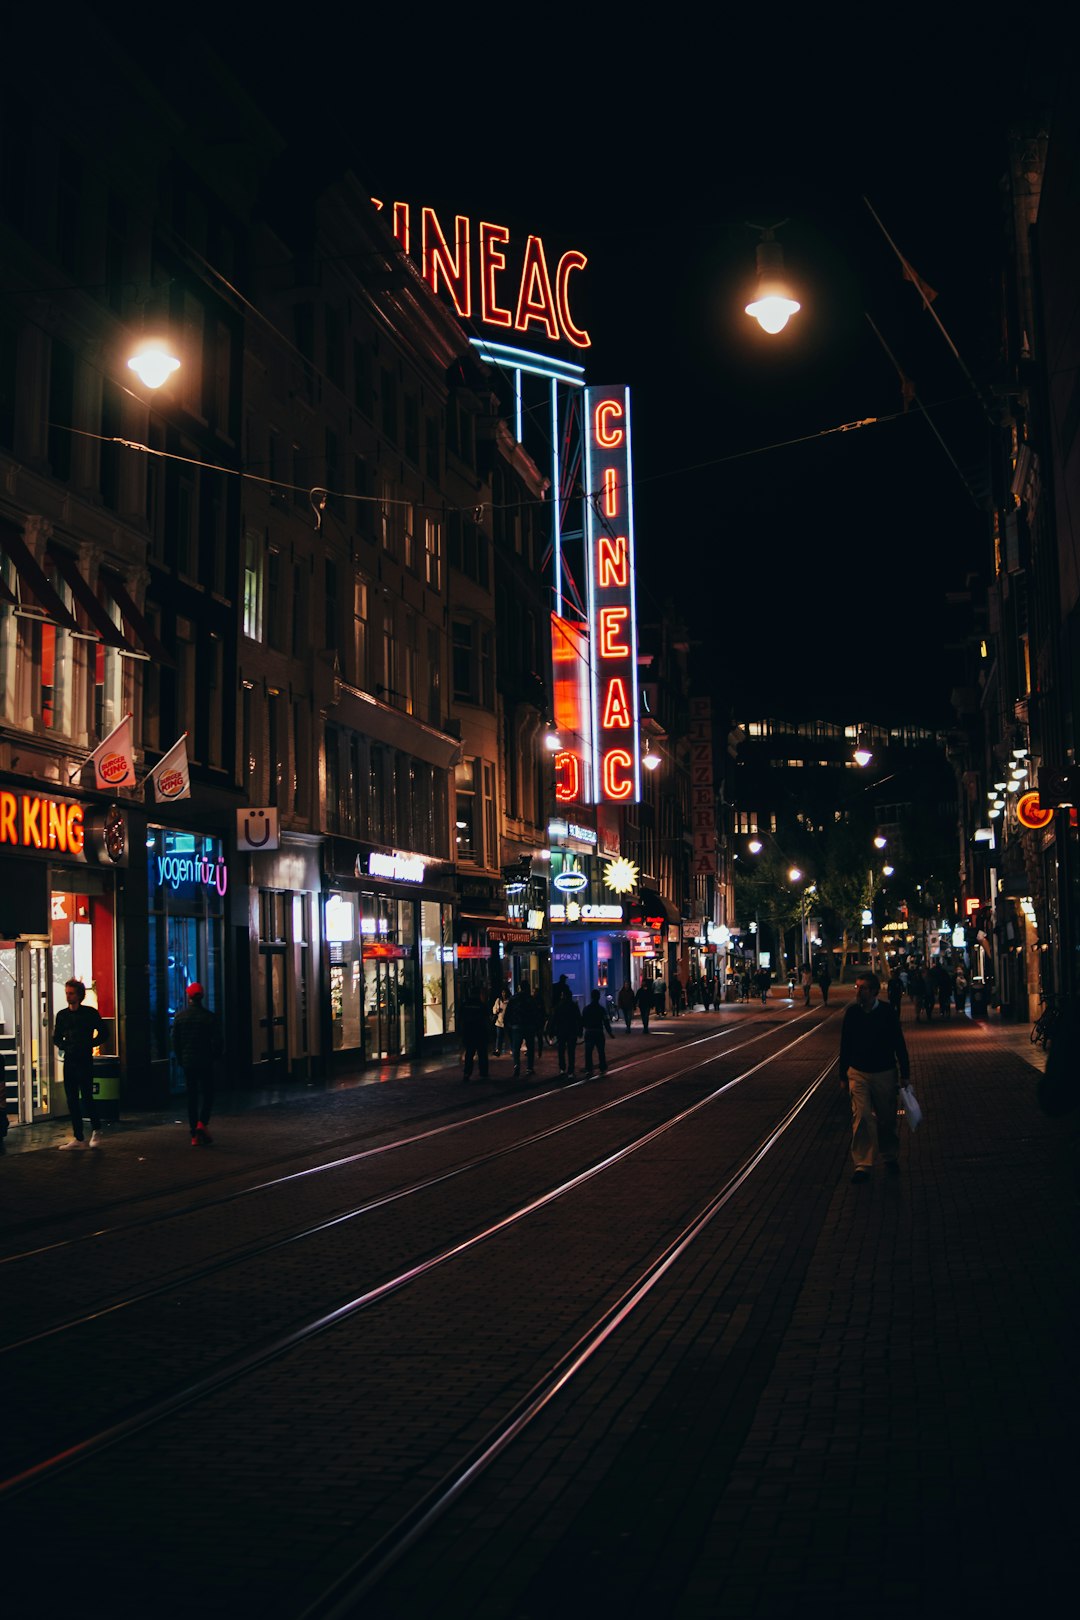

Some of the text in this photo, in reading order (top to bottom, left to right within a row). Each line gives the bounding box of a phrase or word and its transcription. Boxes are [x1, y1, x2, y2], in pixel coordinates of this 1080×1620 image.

[370, 197, 592, 348] INEAC
[594, 399, 632, 800] CINEAC
[101, 756, 125, 771] BURGER
[103, 761, 127, 779] KING
[162, 777, 184, 793] KING
[692, 701, 714, 871] PIZZERIA
[22, 794, 85, 855] KING
[158, 856, 194, 889] yogen
